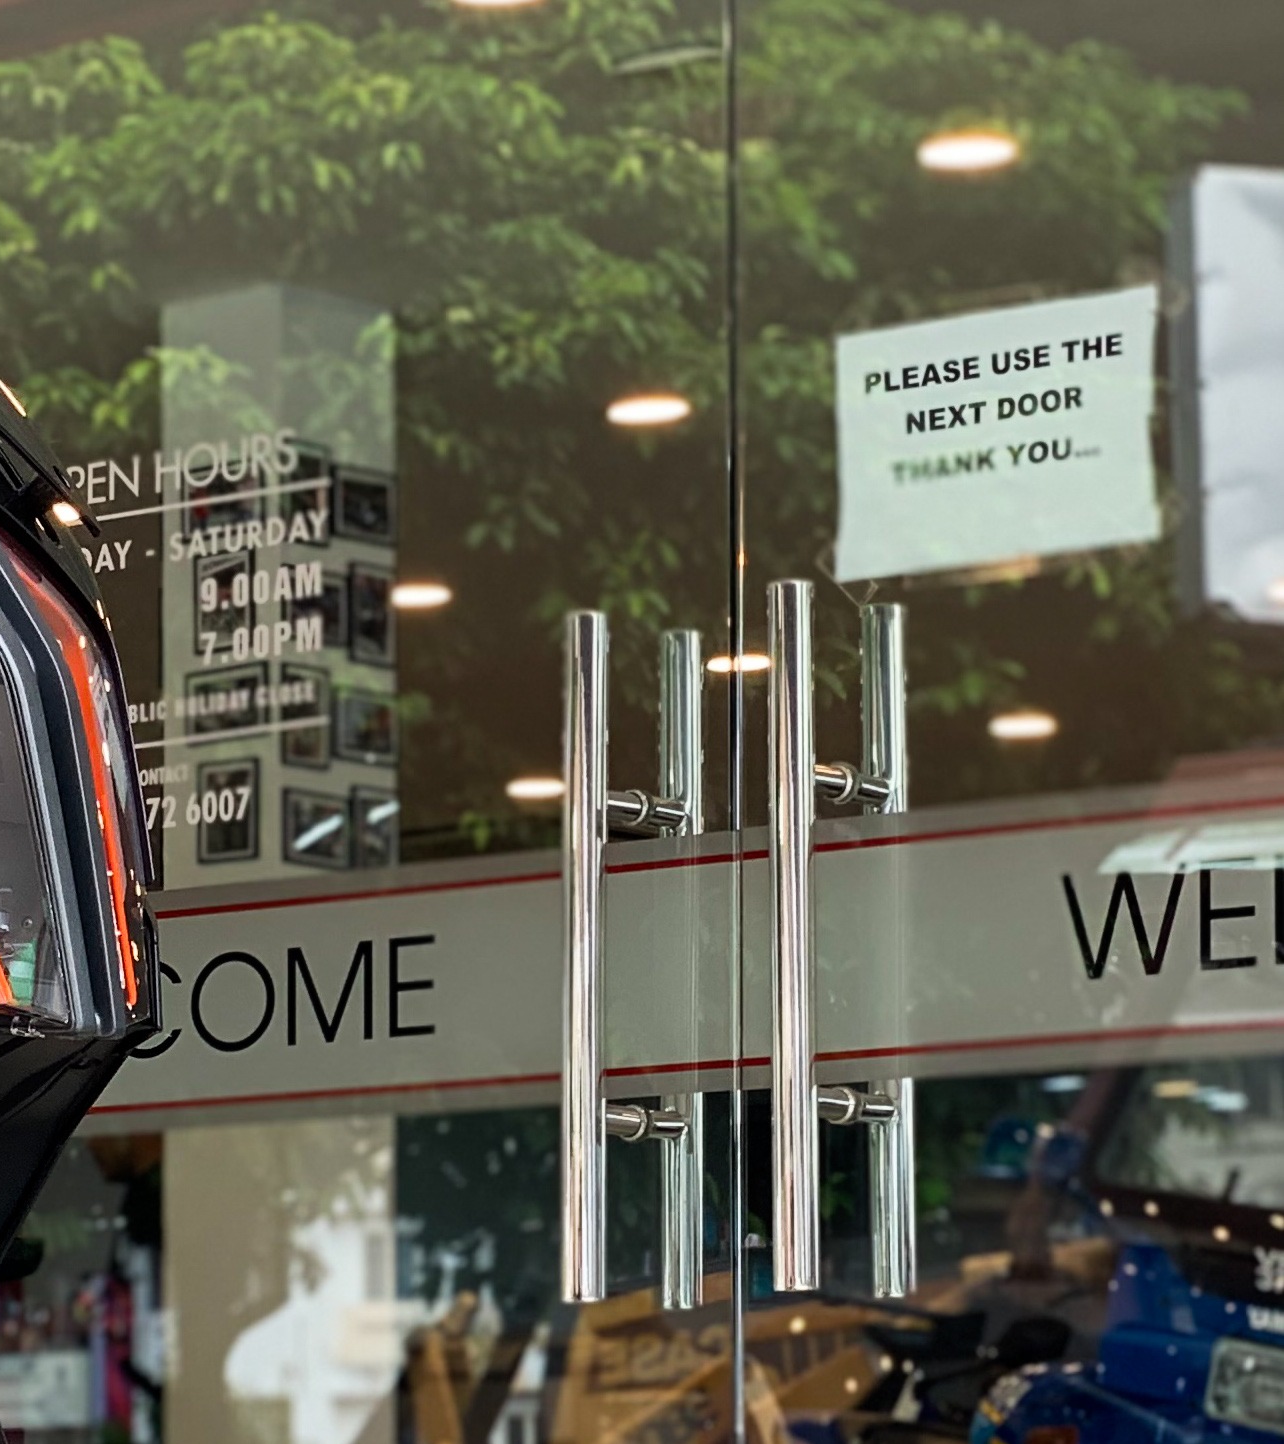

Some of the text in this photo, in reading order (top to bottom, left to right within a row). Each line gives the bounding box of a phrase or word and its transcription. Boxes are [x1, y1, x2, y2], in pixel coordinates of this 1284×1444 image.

[863, 332, 1124, 395] PLEASE USE THE
[905, 385, 1084, 435] NEXT DOOR
[154, 427, 300, 494] HOURS
[891, 446, 996, 487] THANK
[169, 508, 328, 562] SATURDAY
[199, 560, 322, 613] 9.00AM
[199, 614, 323, 667] 7.00PM
[145, 786, 252, 831] 72 6007
